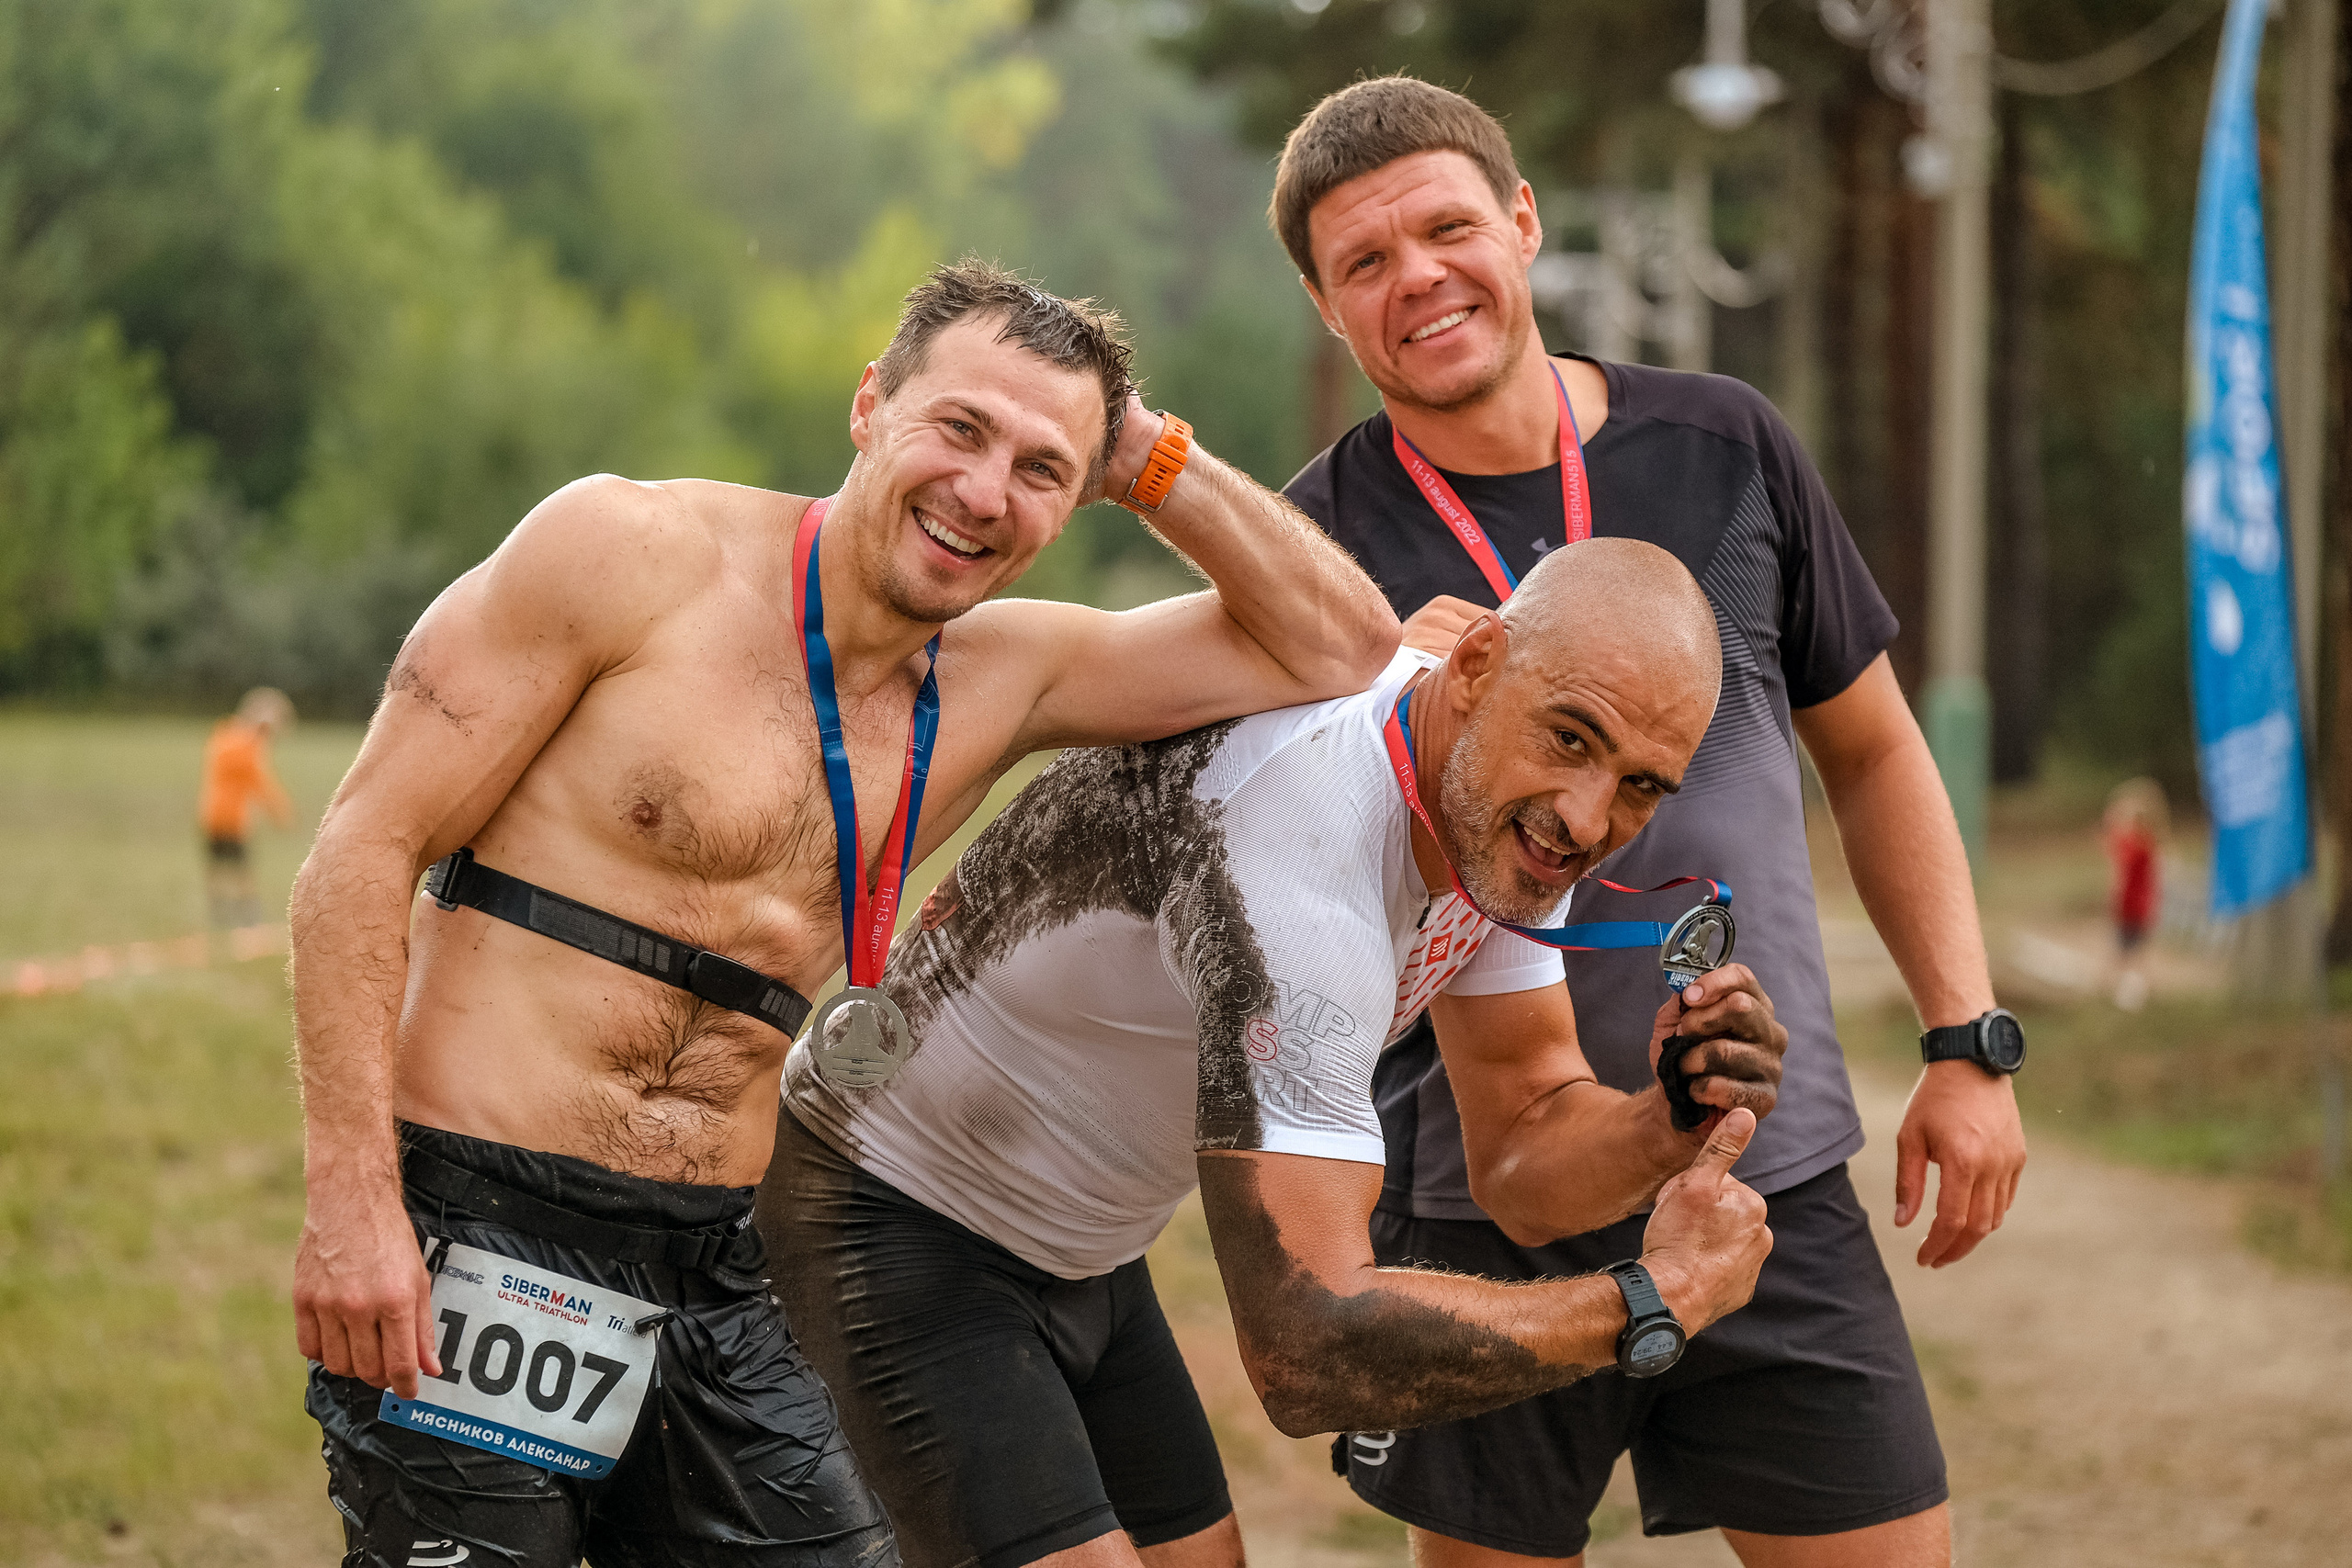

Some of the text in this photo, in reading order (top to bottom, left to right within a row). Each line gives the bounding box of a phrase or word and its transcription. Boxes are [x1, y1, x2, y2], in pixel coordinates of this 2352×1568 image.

[1411, 459, 1481, 546] 11-13 august 2022
[1566, 449, 1586, 542] SIBERMAN515
[1399, 762, 1413, 797] 11-13
[876, 886, 895, 922] 11-13
[1669, 972, 1696, 983] SIBERM
[497, 1290, 588, 1326] ULTRA TRIATHLON
[501, 1274, 593, 1315] SIBERMAN
[429, 1307, 630, 1425] 1007
[410, 1409, 592, 1472] МЯСНИКОВ АЛЕКСАНДР
